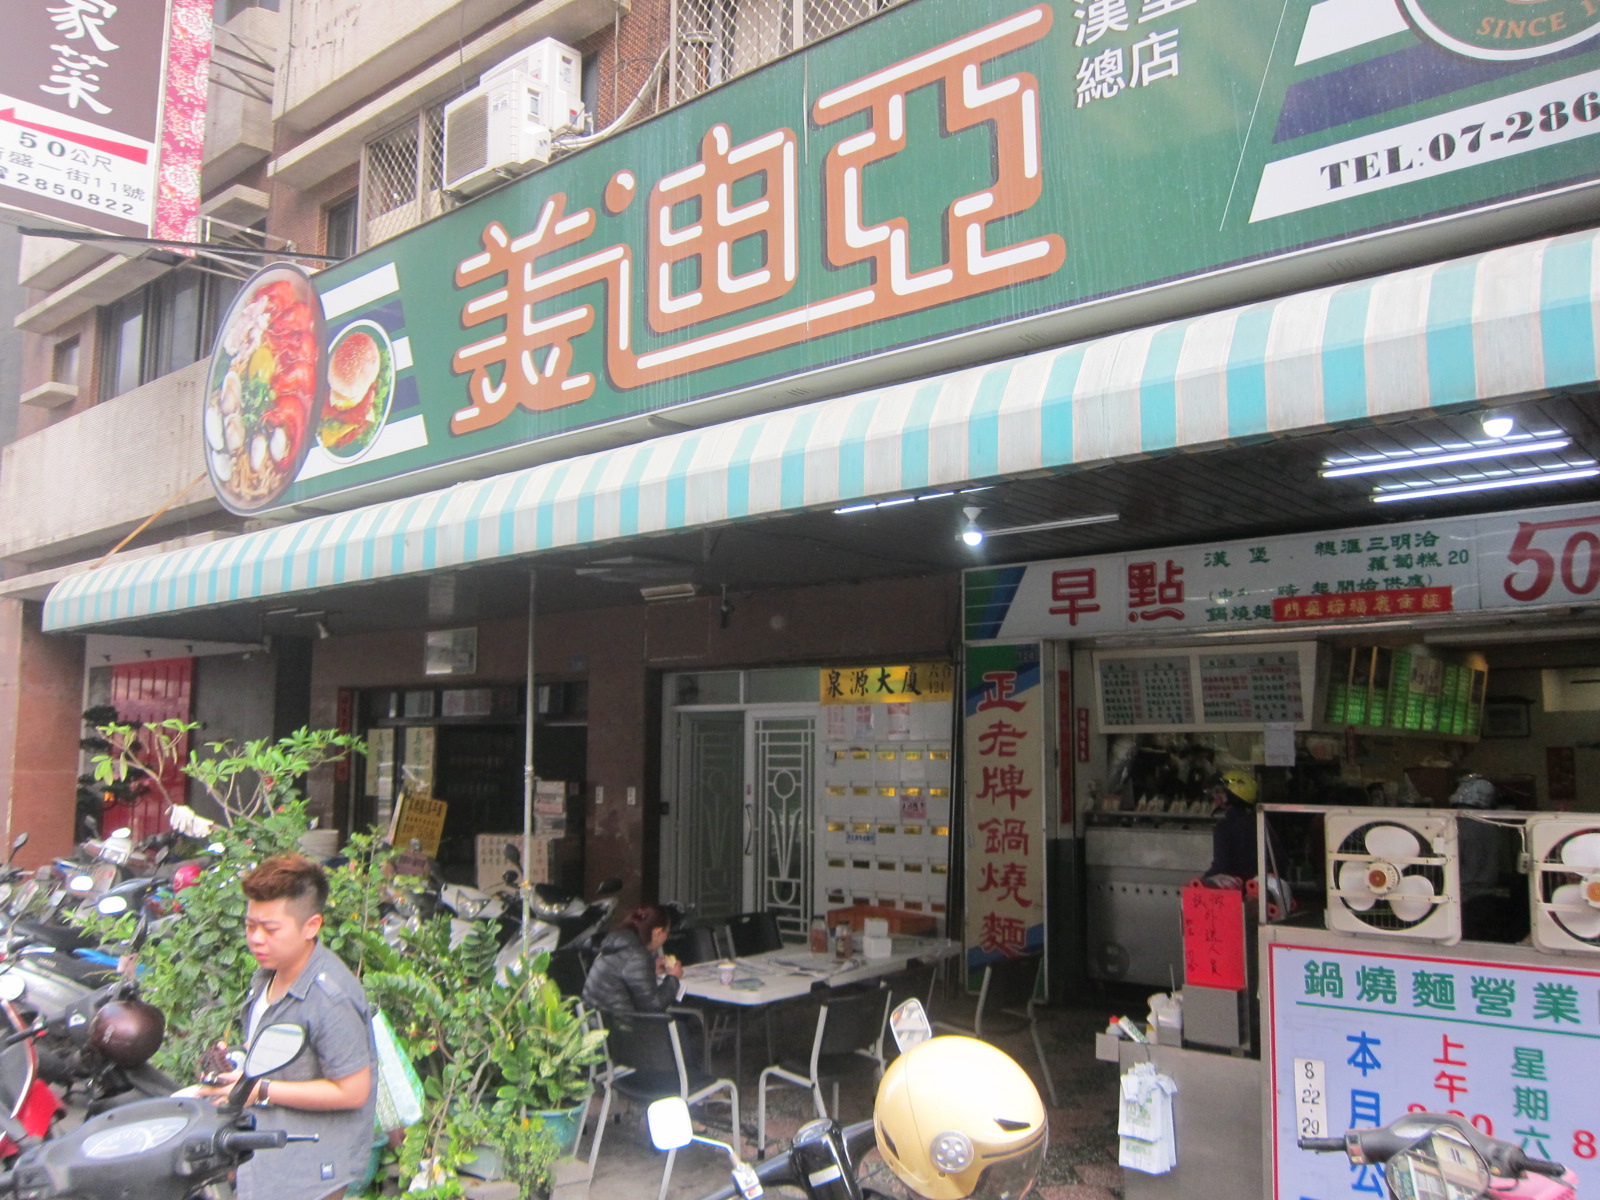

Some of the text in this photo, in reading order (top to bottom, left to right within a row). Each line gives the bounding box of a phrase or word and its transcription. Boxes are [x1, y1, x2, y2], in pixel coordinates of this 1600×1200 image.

[1475, 11, 1568, 39] SINCE
[1076, 28, 1179, 108] 總店
[17, 172, 134, 216] 2850822
[1447, 549, 1469, 565] 20
[1503, 515, 1600, 602] 50
[1049, 559, 1186, 627] 早點
[826, 665, 922, 697] 泉源大廈
[976, 671, 1034, 958] 正老牌鍋燒麵
[1303, 960, 1600, 1025] 鍋燒麵營業
[1432, 1034, 1468, 1103] 上午
